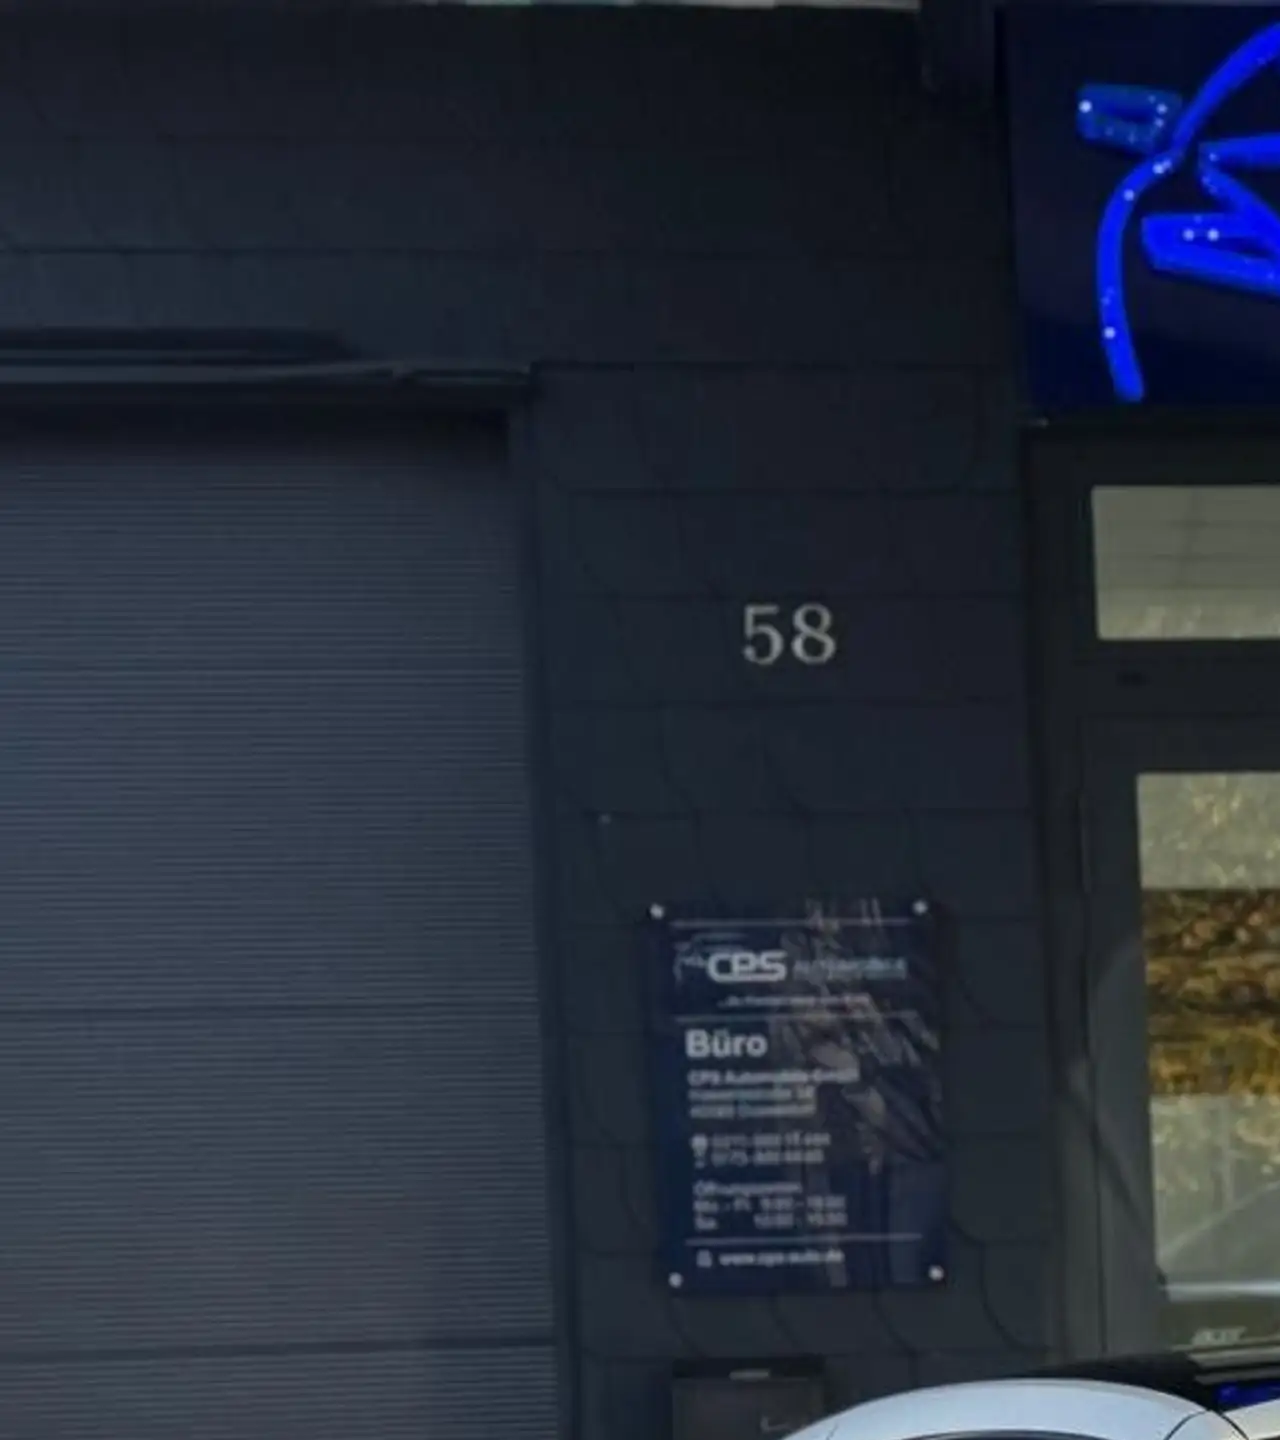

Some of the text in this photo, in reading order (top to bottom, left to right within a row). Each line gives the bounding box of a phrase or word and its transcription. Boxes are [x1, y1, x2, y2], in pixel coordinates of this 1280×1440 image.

[742, 602, 837, 666] 58
[707, 950, 788, 982] CPS
[685, 1028, 768, 1058] Büro
